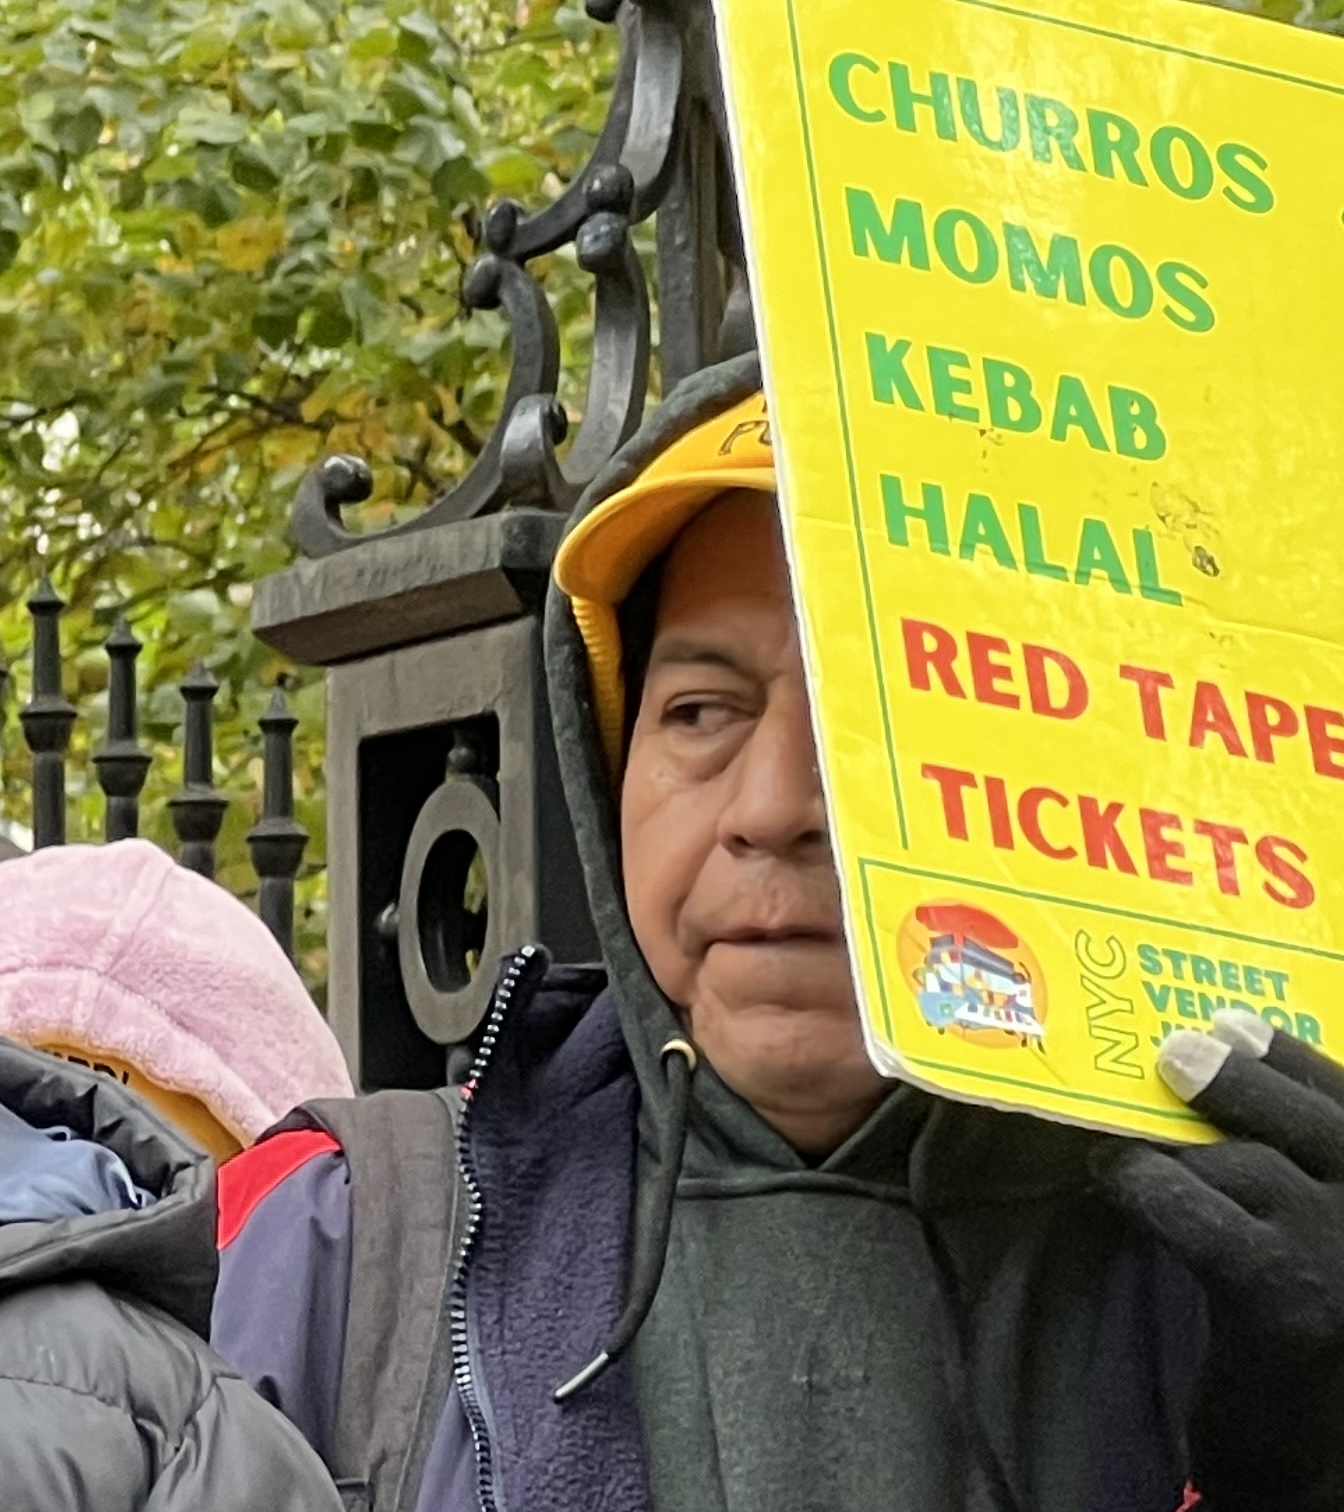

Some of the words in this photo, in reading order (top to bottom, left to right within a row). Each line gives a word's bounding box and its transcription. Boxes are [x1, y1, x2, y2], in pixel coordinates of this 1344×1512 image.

[828, 52, 1275, 214] CHURROS
[845, 187, 1216, 333] MOMOS
[865, 332, 1167, 462] KEBAB
[880, 473, 1182, 605] HALAL
[901, 617, 1090, 720] RED
[921, 763, 1316, 910] TICKETS
[1074, 928, 1145, 1080] NYC
[1136, 943, 1290, 1002] STREET
